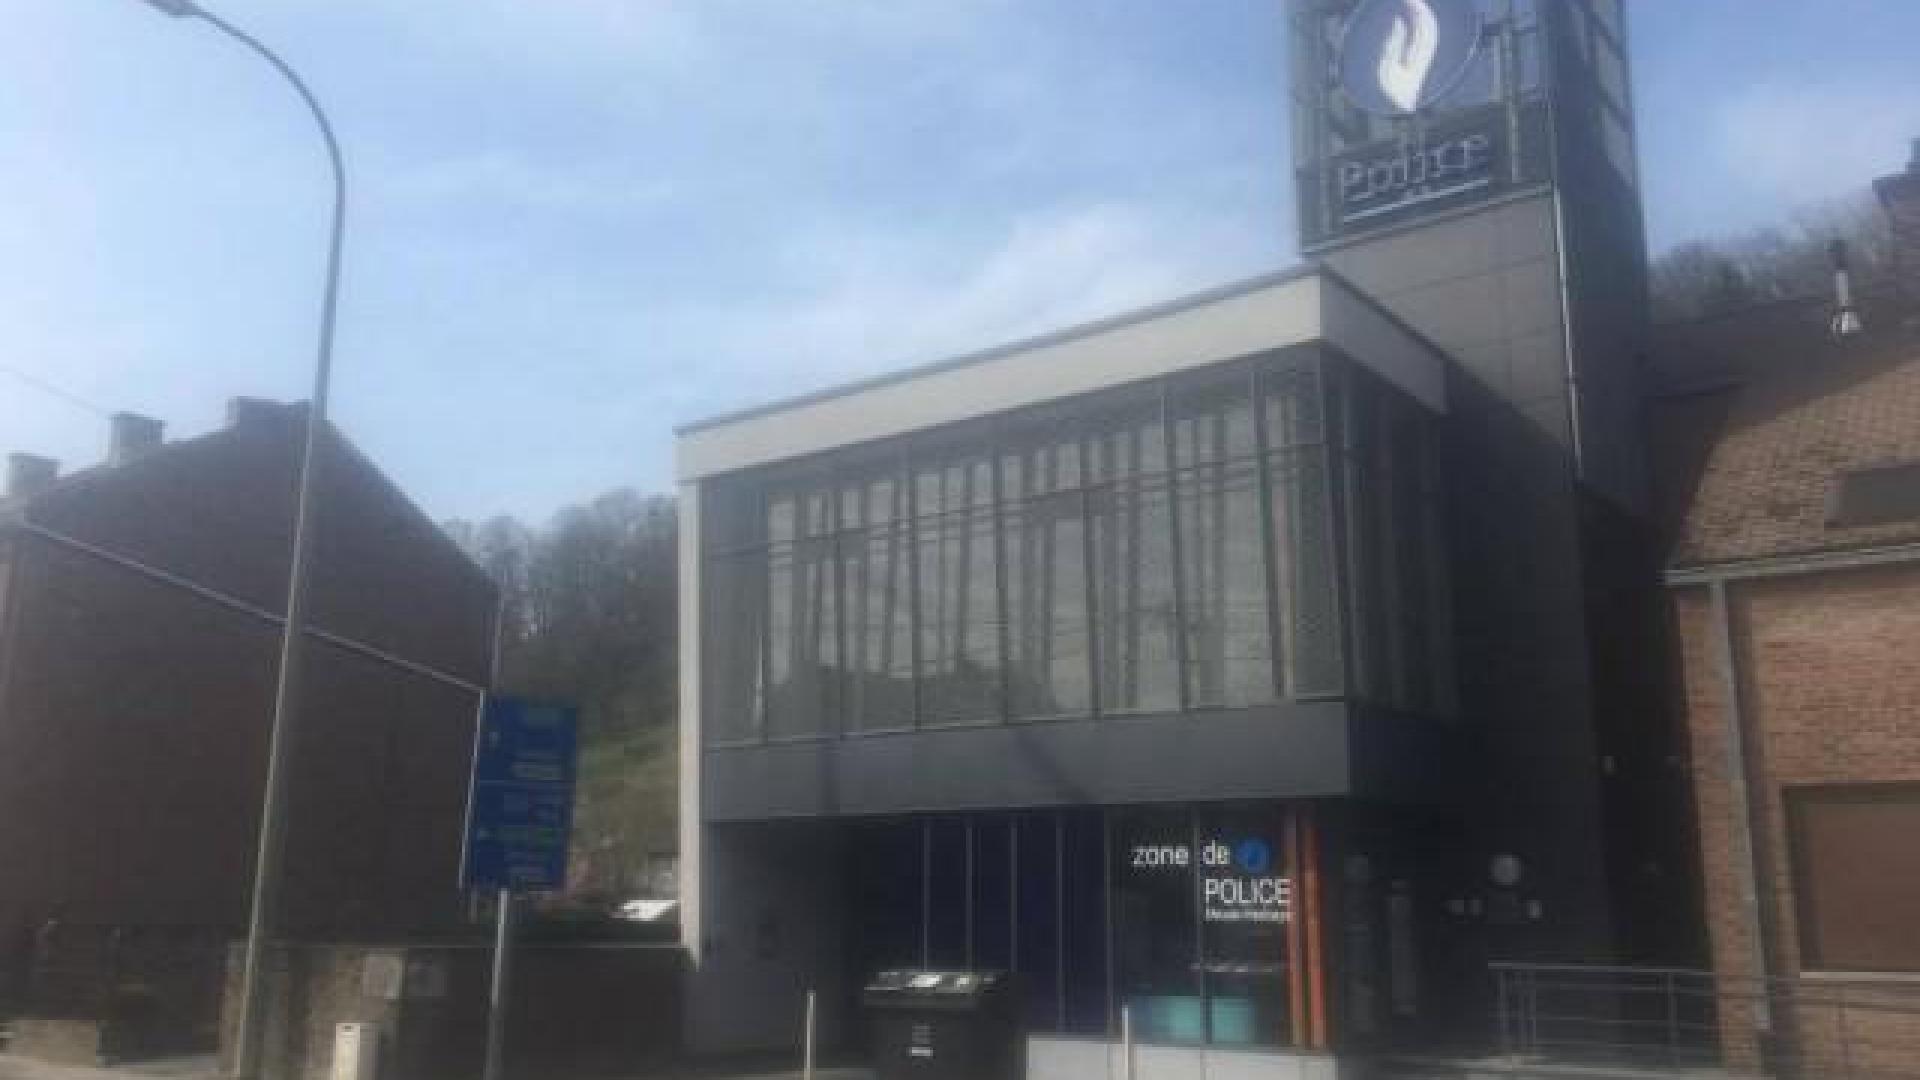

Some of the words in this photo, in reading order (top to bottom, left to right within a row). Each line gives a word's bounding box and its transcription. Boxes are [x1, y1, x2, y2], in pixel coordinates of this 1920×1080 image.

[1133, 846, 1189, 866] zone
[1202, 840, 1230, 865] de
[1205, 878, 1292, 904] POLICE
